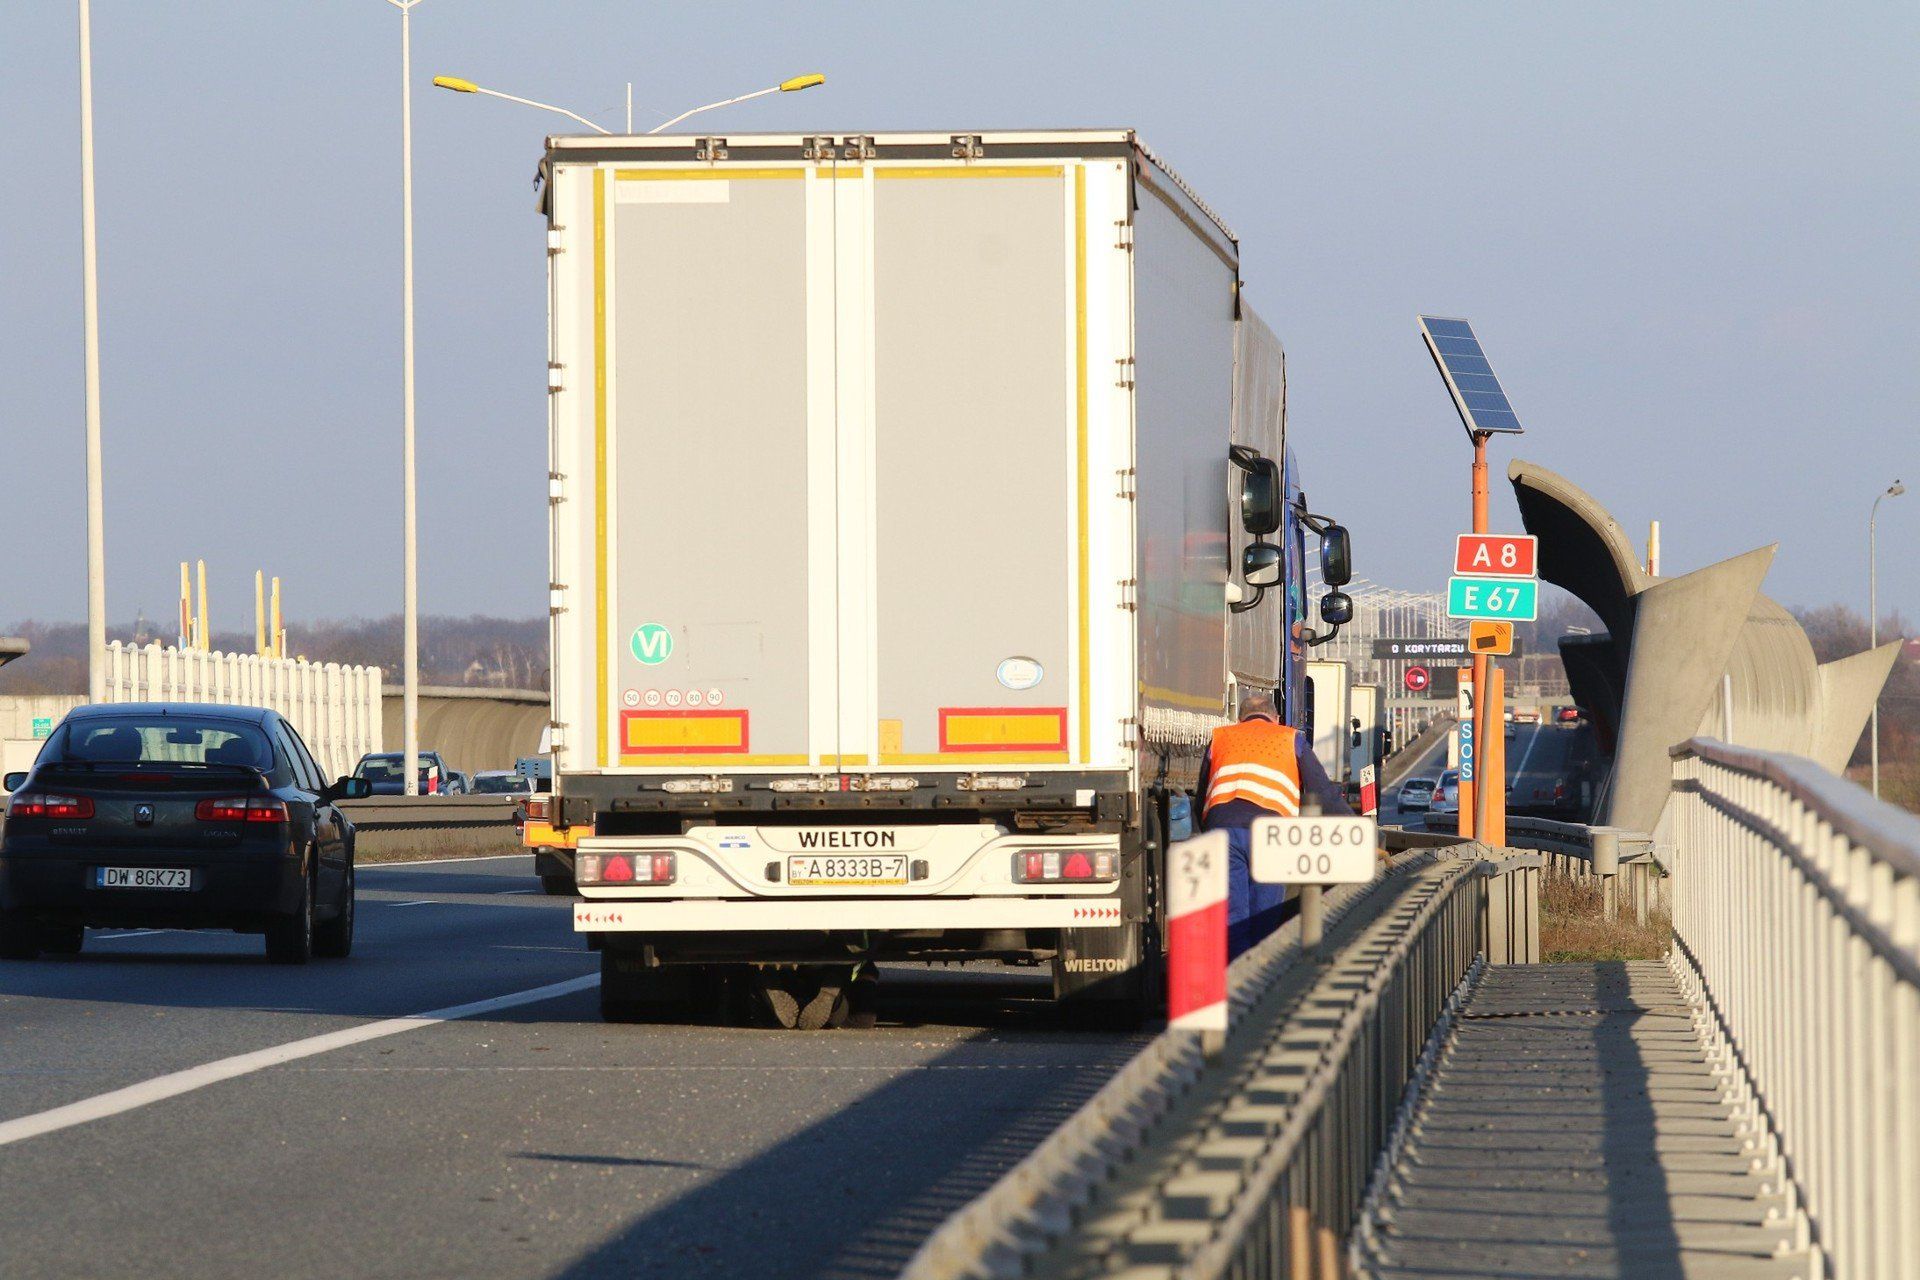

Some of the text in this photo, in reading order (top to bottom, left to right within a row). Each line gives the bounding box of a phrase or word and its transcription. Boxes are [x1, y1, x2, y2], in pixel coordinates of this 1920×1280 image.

[1472, 543, 1517, 568] A 8
[1464, 585, 1520, 612] E 67
[637, 629, 667, 658] VI
[1404, 643, 1465, 654] KORYTARZU
[627, 694, 638, 702] 50
[647, 694, 657, 702] 60
[668, 694, 679, 702] 70
[689, 694, 700, 702] 80
[709, 693, 720, 701] 90
[1461, 722, 1473, 778] SOS
[798, 830, 895, 848] WIELTON
[1182, 850, 1211, 873] 24
[107, 868, 187, 886] DW 8GK73
[1189, 876, 1199, 898] 7
[1064, 958, 1127, 973] WIELTON
